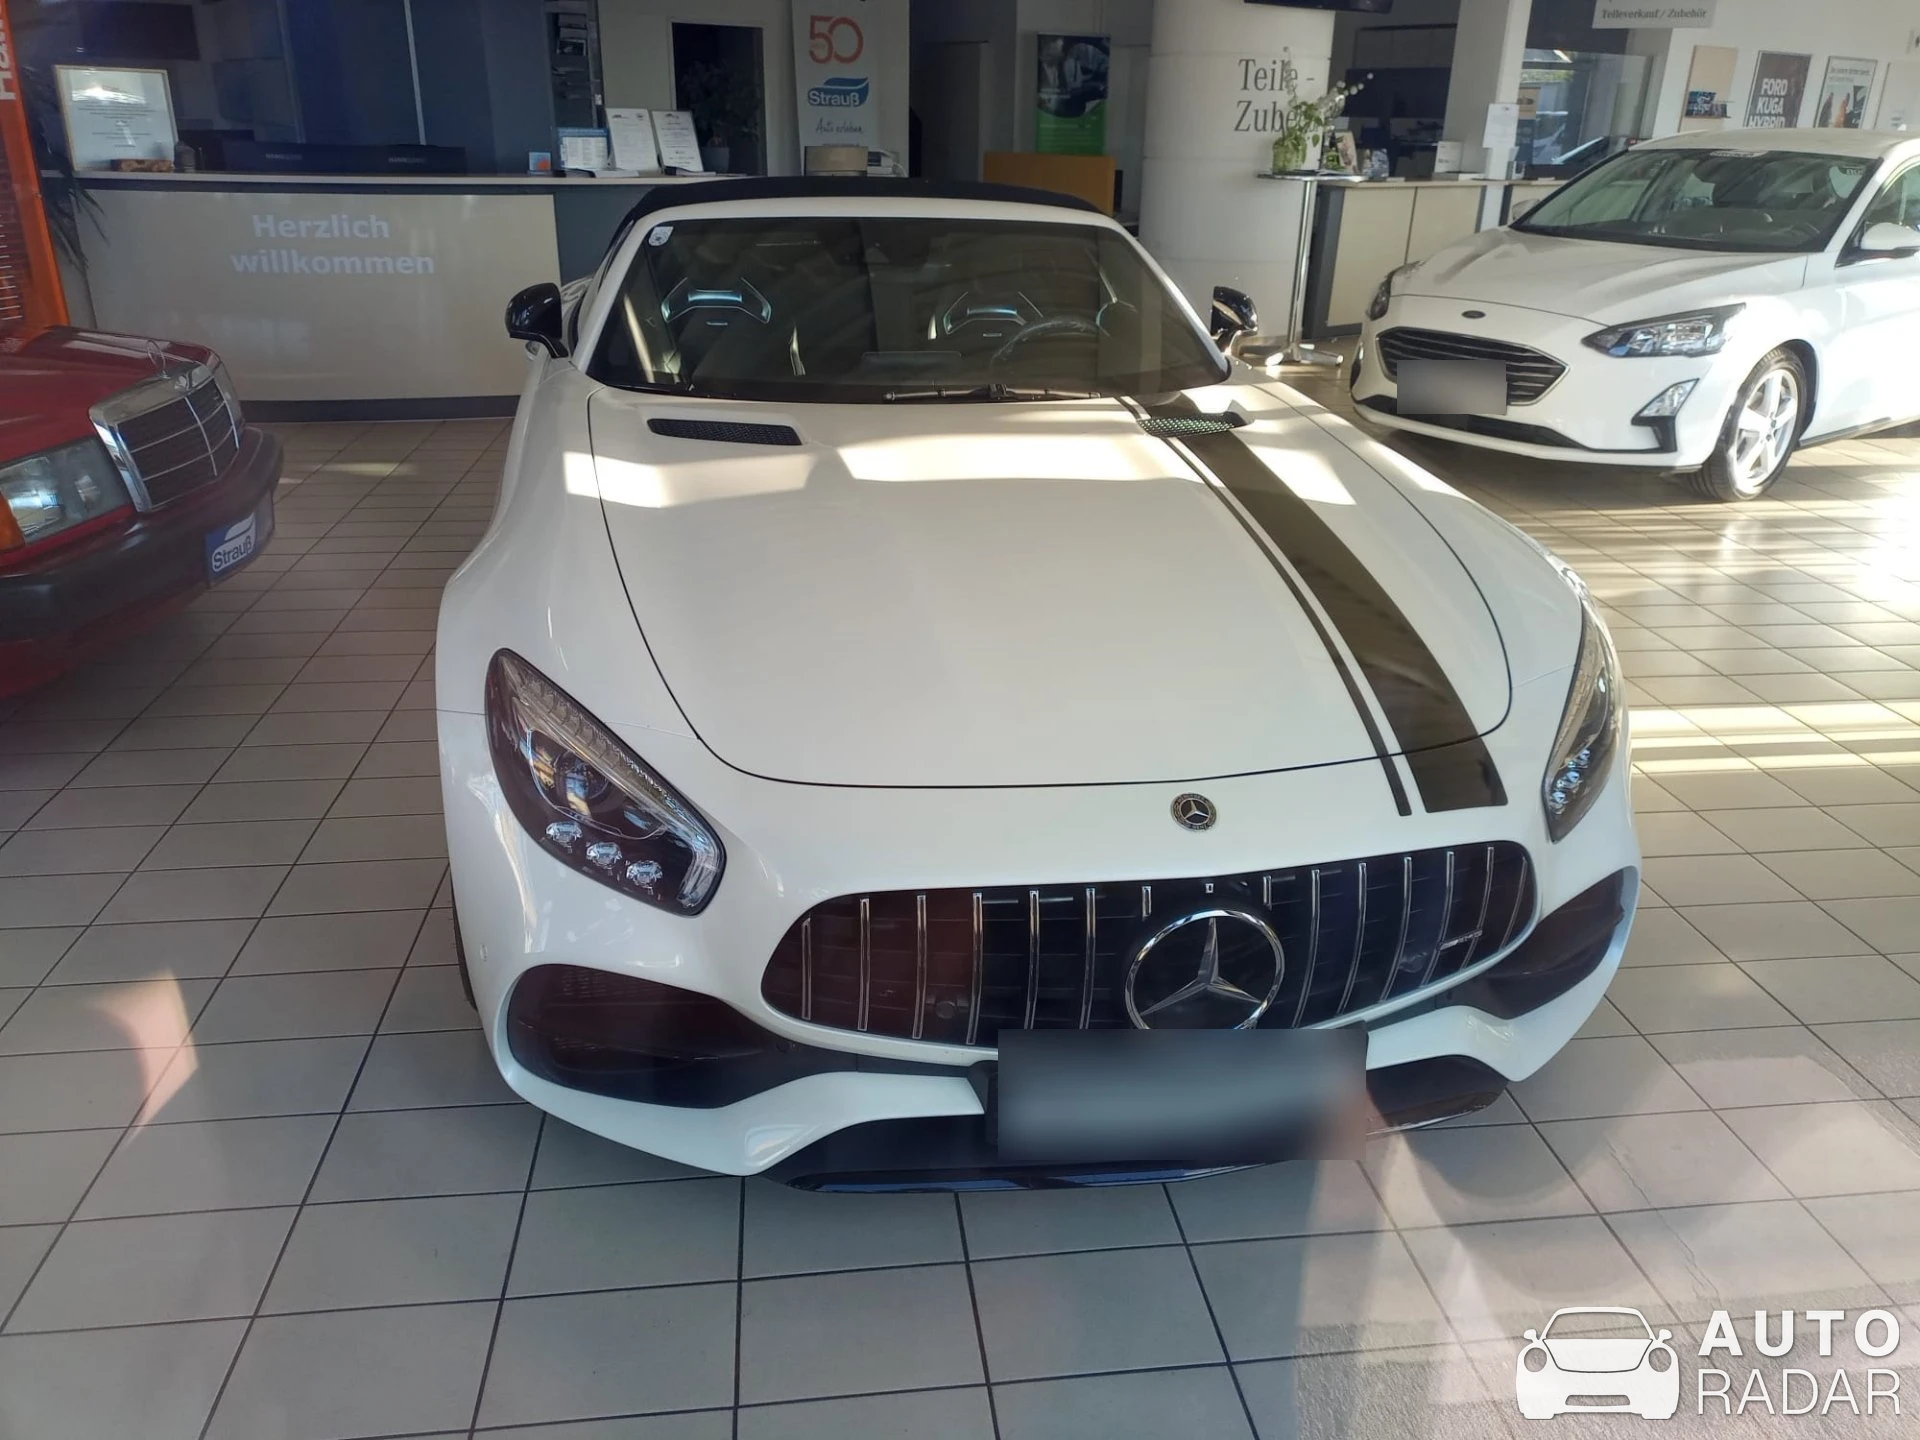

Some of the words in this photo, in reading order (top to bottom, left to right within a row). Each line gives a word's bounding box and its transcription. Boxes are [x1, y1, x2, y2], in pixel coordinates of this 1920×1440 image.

[1602, 8, 1660, 19] Teileverkauf
[1667, 8, 1707, 18] Zubehör
[809, 15, 864, 65] 50
[1239, 58, 1298, 91] Teile
[1761, 78, 1788, 96] FORD
[808, 90, 861, 106] Strauß
[1756, 97, 1784, 115] KUGA
[252, 213, 391, 239] Herzlich
[230, 248, 436, 275] willkommen
[213, 535, 253, 569] Strauß
